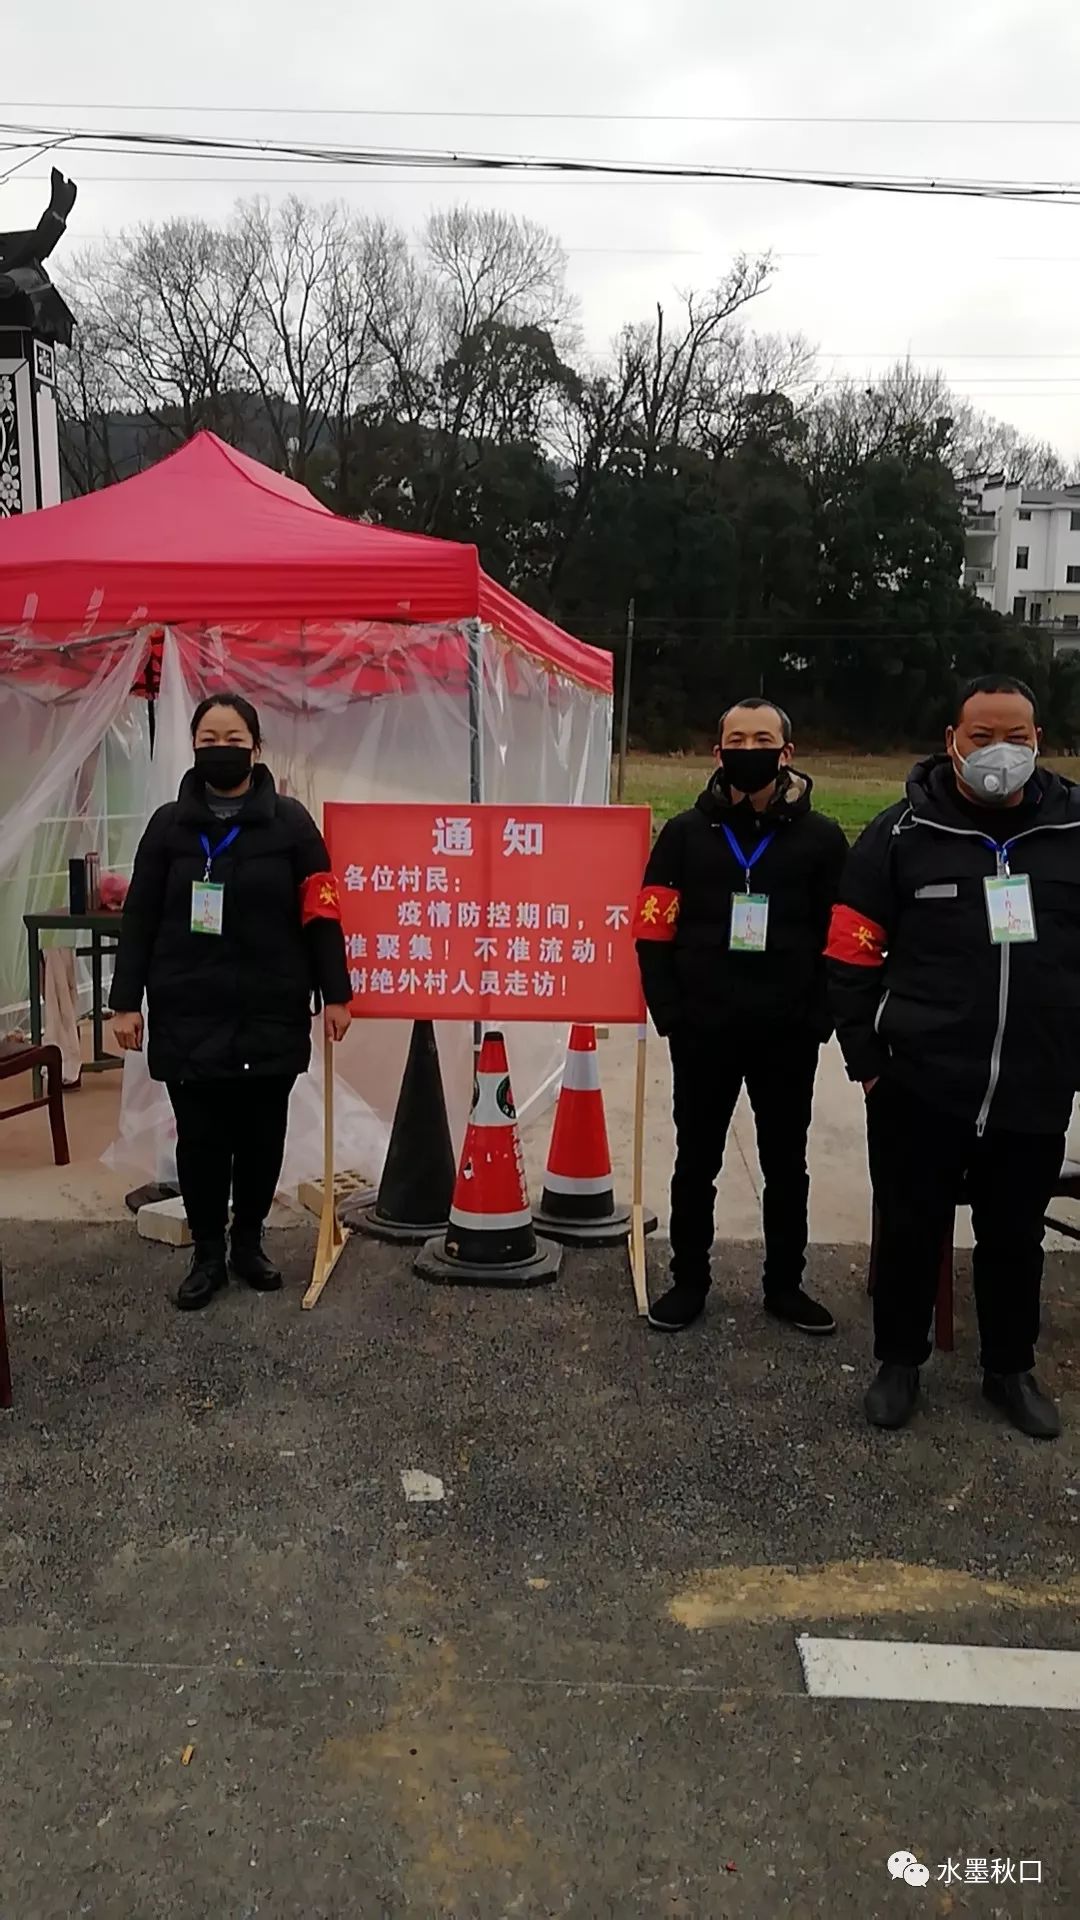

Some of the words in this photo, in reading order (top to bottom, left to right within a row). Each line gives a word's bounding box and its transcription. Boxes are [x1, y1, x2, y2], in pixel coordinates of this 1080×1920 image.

[431, 817, 544, 856] 通知
[344, 865, 461, 893] 各位村民：
[397, 901, 629, 931] 疫情防控期间，不
[344, 933, 613, 963] 准聚集！不准流动！
